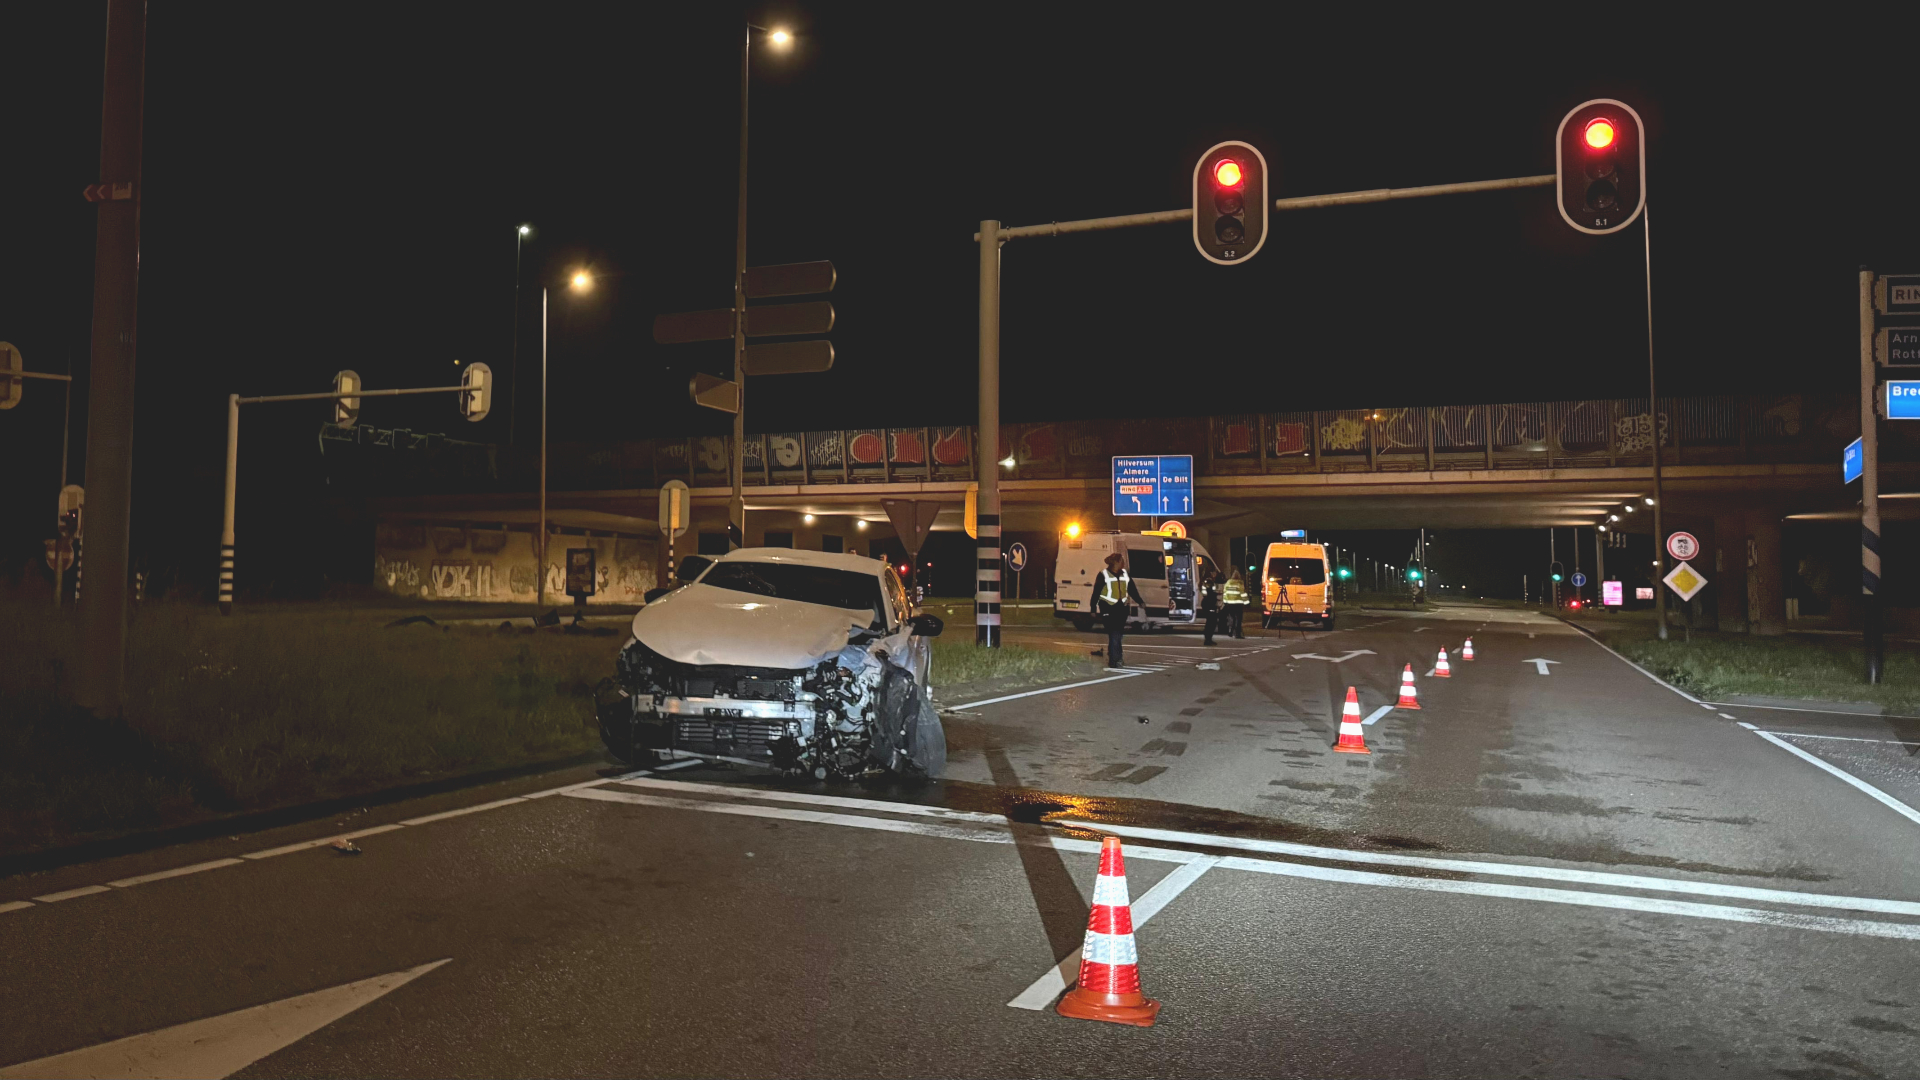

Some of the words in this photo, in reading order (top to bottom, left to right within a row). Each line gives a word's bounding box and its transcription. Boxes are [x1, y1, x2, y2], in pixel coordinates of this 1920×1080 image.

[1595, 218, 1607, 226] 5.1
[1224, 250, 1235, 258] 5.2
[1117, 459, 1155, 467] Hilversum
[1115, 476, 1157, 484] Amsterdam
